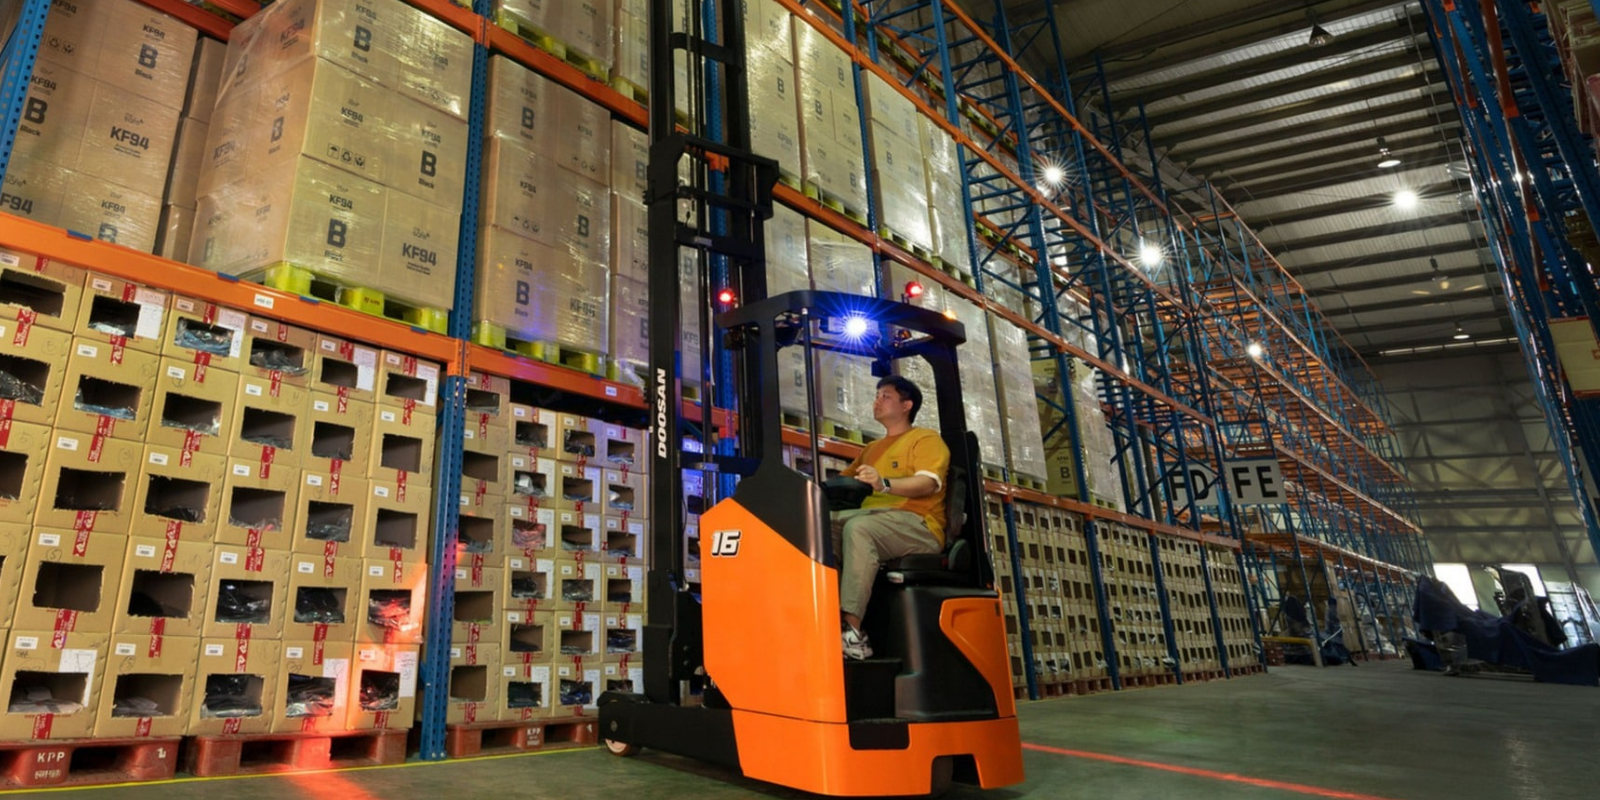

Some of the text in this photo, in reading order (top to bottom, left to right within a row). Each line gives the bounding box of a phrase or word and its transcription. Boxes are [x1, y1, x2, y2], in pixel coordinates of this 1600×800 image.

[142, 24, 166, 39] KF94
[353, 25, 372, 52] B
[138, 43, 159, 69] B
[31, 75, 57, 91] KF94
[134, 68, 153, 81] Black
[24, 96, 48, 125] B
[340, 106, 364, 124] KF94
[521, 105, 535, 131] B
[20, 125, 41, 138] Black
[110, 126, 150, 151] KF94
[420, 150, 437, 178] B
[0, 192, 33, 215] F94
[101, 198, 126, 214] KF94
[329, 193, 353, 211] KF94
[327, 218, 347, 249] B
[577, 214, 589, 239] B
[402, 242, 437, 267] KF94
[516, 280, 530, 306] B
[657, 368, 668, 459] DOOSAN
[1060, 466, 1071, 479] B
[711, 531, 740, 557] 16
[37, 751, 65, 763] KPP
